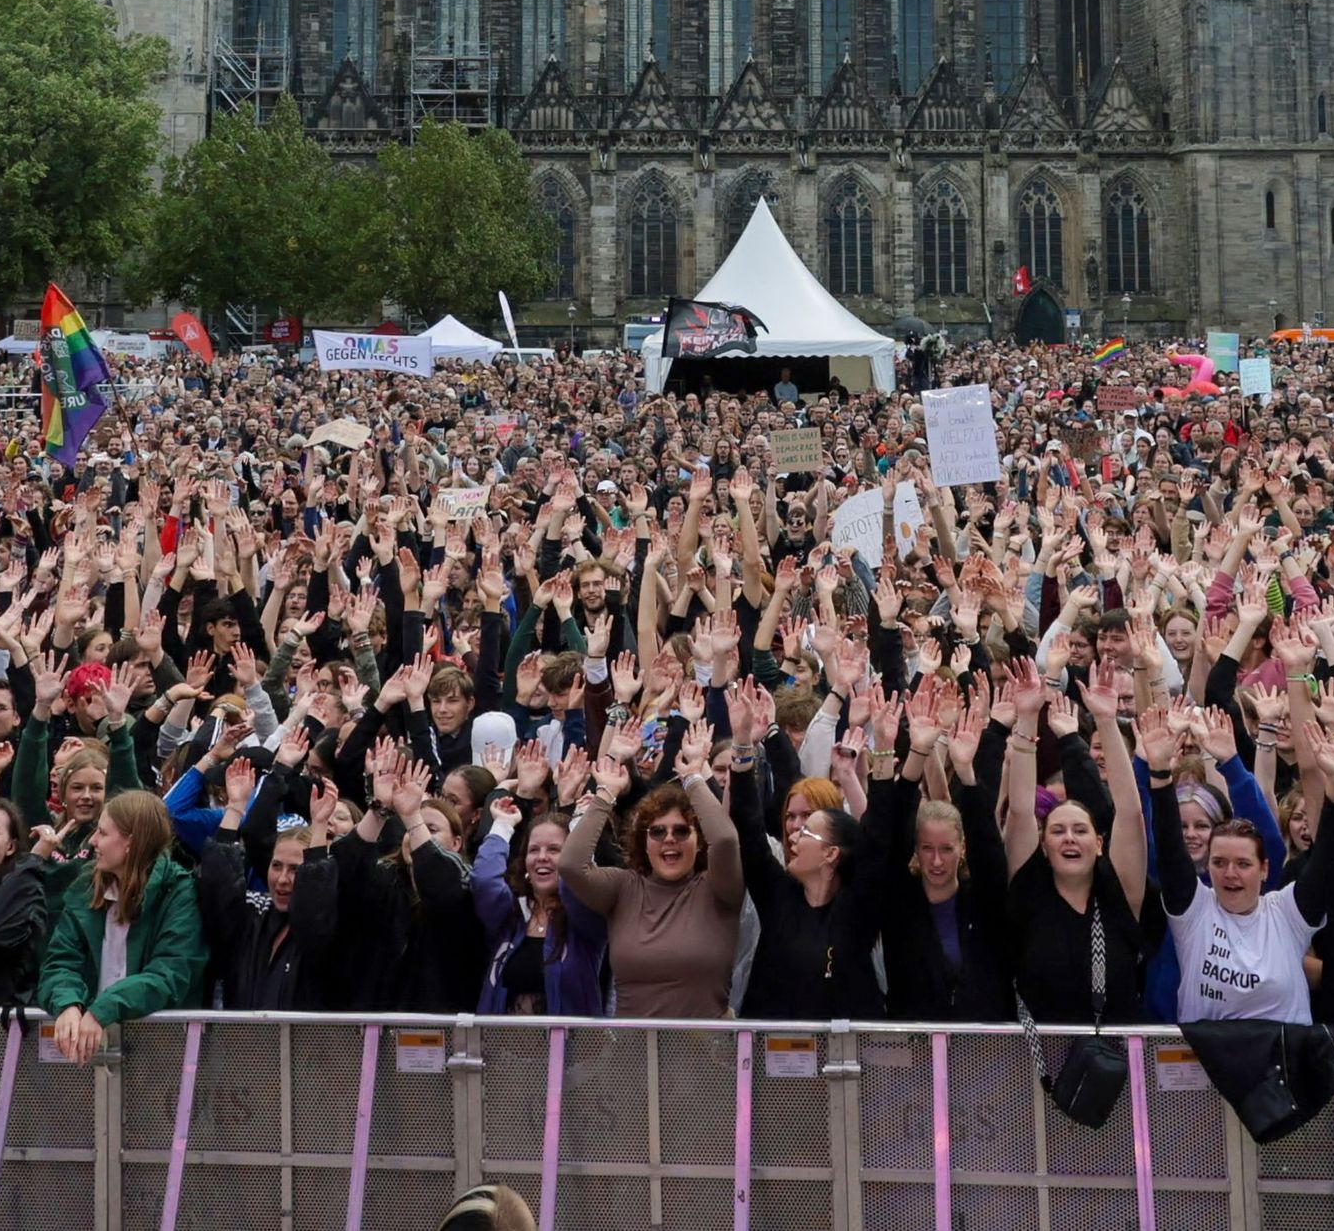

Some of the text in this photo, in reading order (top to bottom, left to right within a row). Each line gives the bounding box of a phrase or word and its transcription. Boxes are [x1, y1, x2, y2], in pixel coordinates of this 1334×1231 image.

[326, 348, 367, 361] GEGEN
[344, 336, 398, 355] OMAS
[1201, 959, 1261, 990] BACKUP
